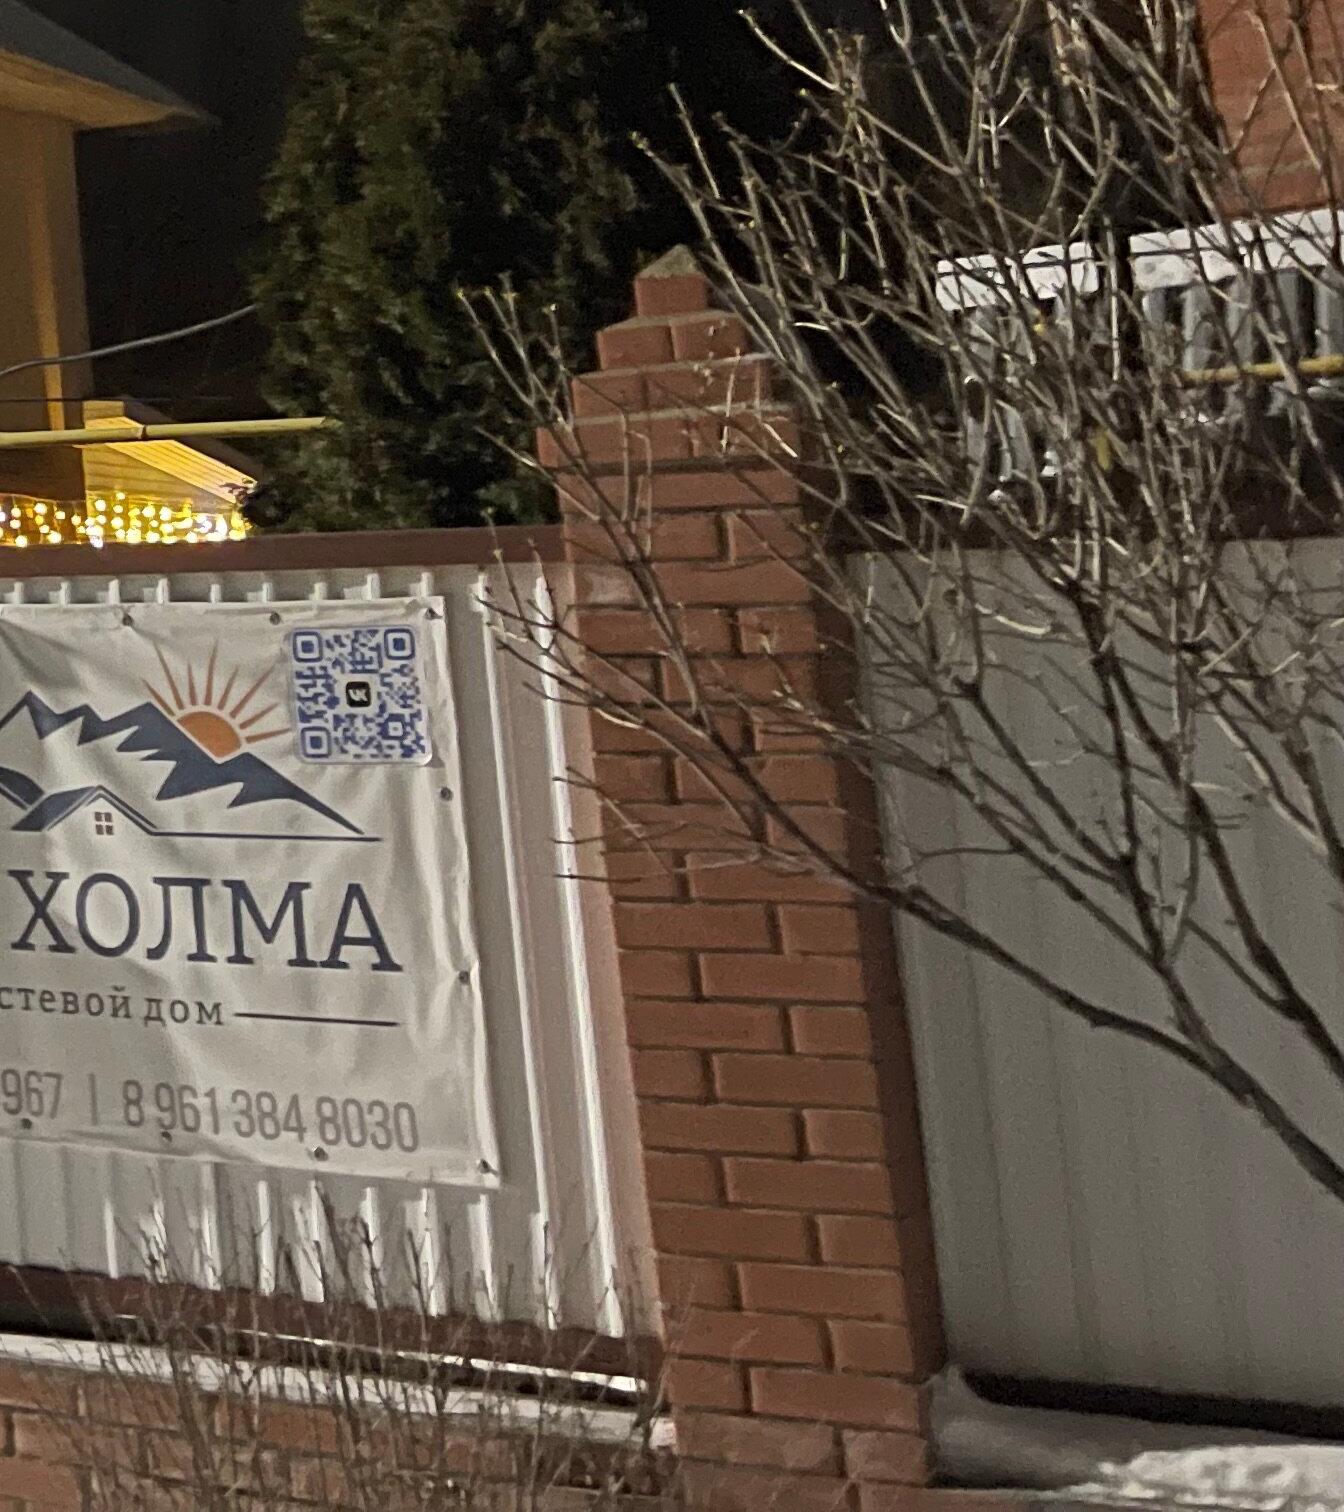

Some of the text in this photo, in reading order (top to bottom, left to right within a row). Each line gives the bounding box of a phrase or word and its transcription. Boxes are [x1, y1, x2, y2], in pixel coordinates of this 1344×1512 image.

[6, 869, 404, 973] ХОЛМА
[143, 997, 225, 1027] дом
[122, 1079, 145, 1127] 8
[154, 1082, 221, 1136] 961
[230, 1089, 307, 1143] 384
[315, 1096, 419, 1153] 8030
